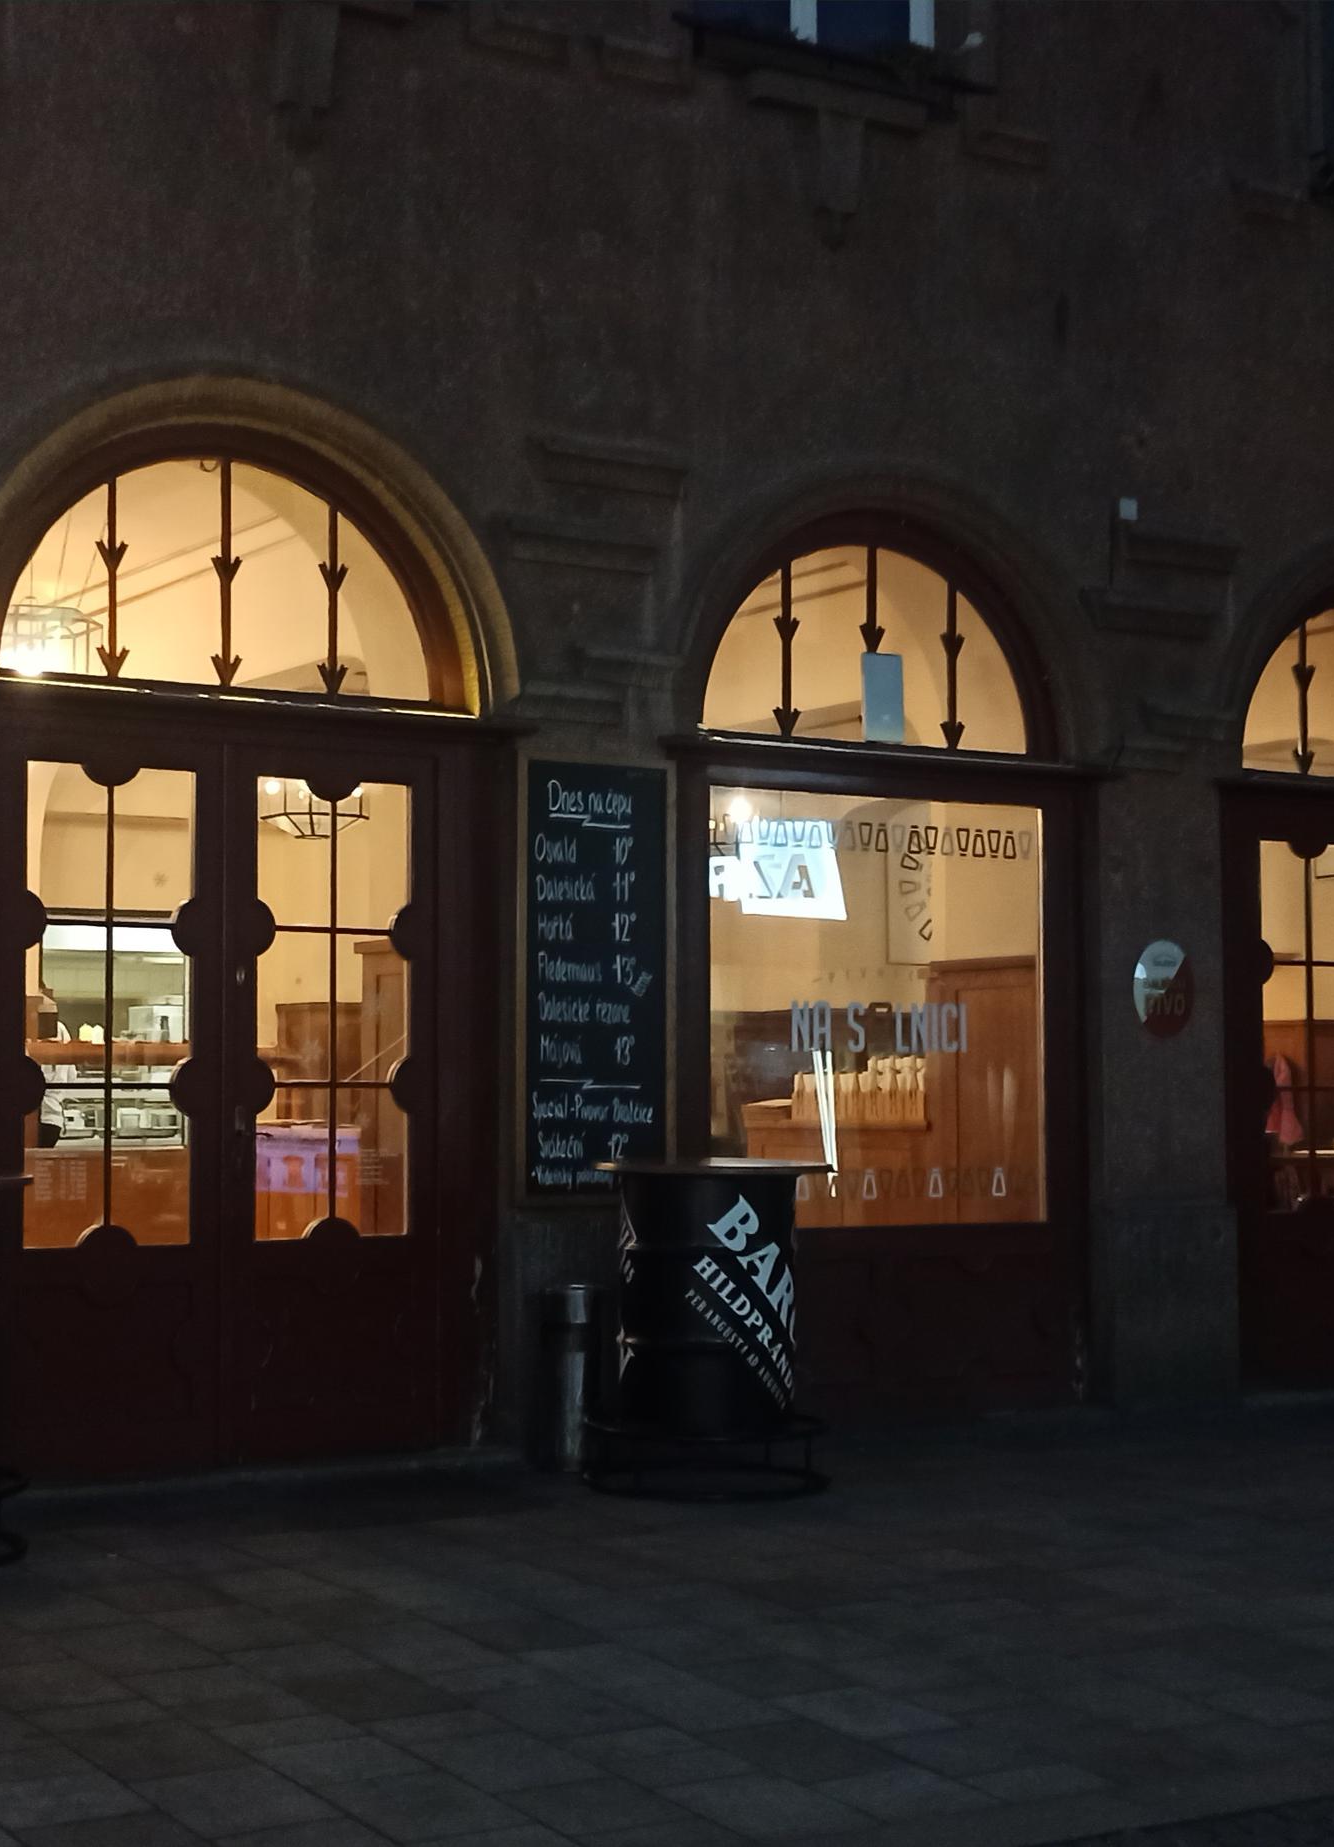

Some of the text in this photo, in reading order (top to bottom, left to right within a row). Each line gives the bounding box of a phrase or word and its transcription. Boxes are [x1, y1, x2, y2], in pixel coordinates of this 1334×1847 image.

[547, 779, 584, 812] Dnes
[588, 790, 604, 814] na
[791, 1000, 832, 1052] NA
[706, 1193, 796, 1345] BAR
[684, 1287, 706, 1314] PER
